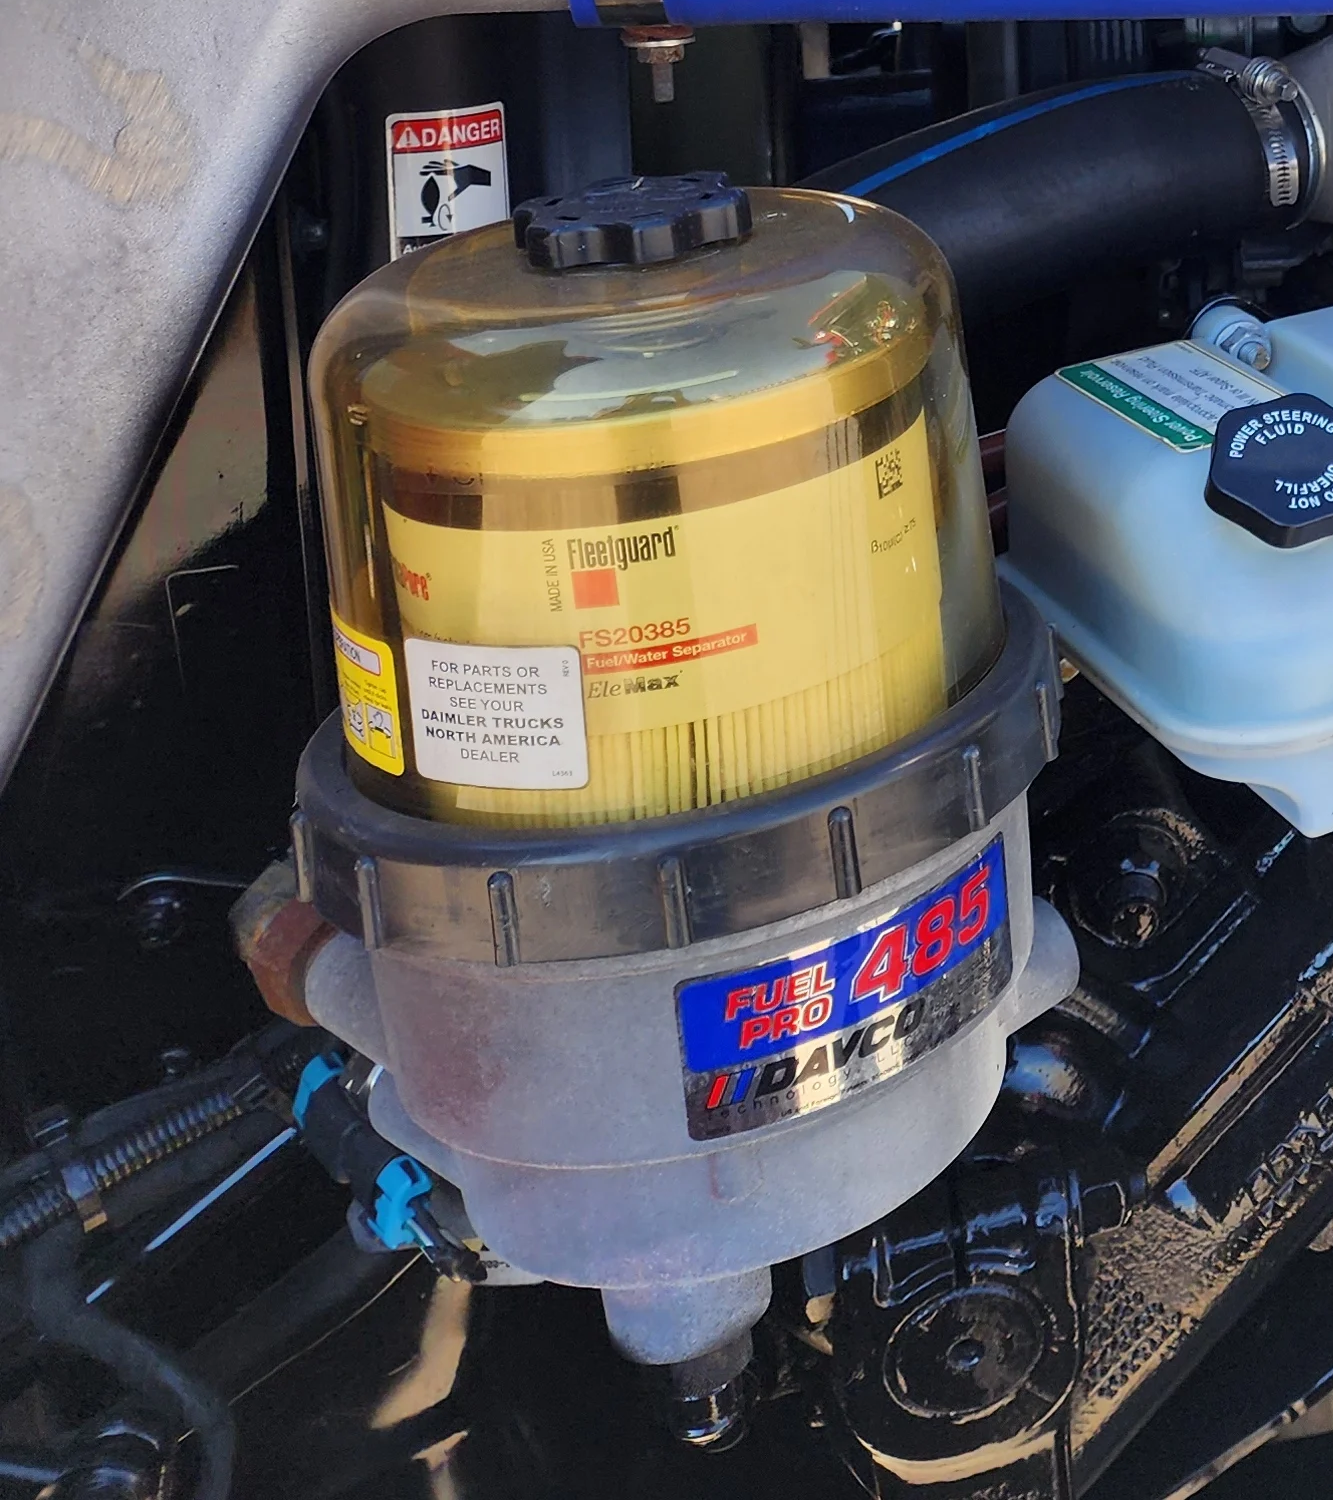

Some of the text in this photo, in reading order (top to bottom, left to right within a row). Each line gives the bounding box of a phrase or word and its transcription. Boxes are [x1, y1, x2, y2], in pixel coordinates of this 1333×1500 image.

[422, 118, 499, 146] DANGER
[1080, 369, 1203, 442] Power Steering Reservoir
[1228, 418, 1263, 459] POWER
[1254, 422, 1305, 446] FLUID
[1288, 497, 1321, 509] NOT
[542, 538, 563, 612] MADE IN USA
[579, 617, 691, 650] FS20385
[586, 631, 747, 670] Fuel/Water Separator
[432, 660, 540, 678] FOR PARTS OR
[428, 676, 548, 694] REPLACEMENTS
[450, 696, 524, 712] SEE YOUR
[422, 708, 564, 729] DAIMLER TRUCKS
[426, 726, 560, 746] NORTH AMERICA
[460, 748, 520, 763] DEALER
[724, 960, 836, 1022] FUEL
[849, 865, 990, 1005] 485
[739, 997, 833, 1050] PRO
[755, 997, 926, 1096] DAVCO
